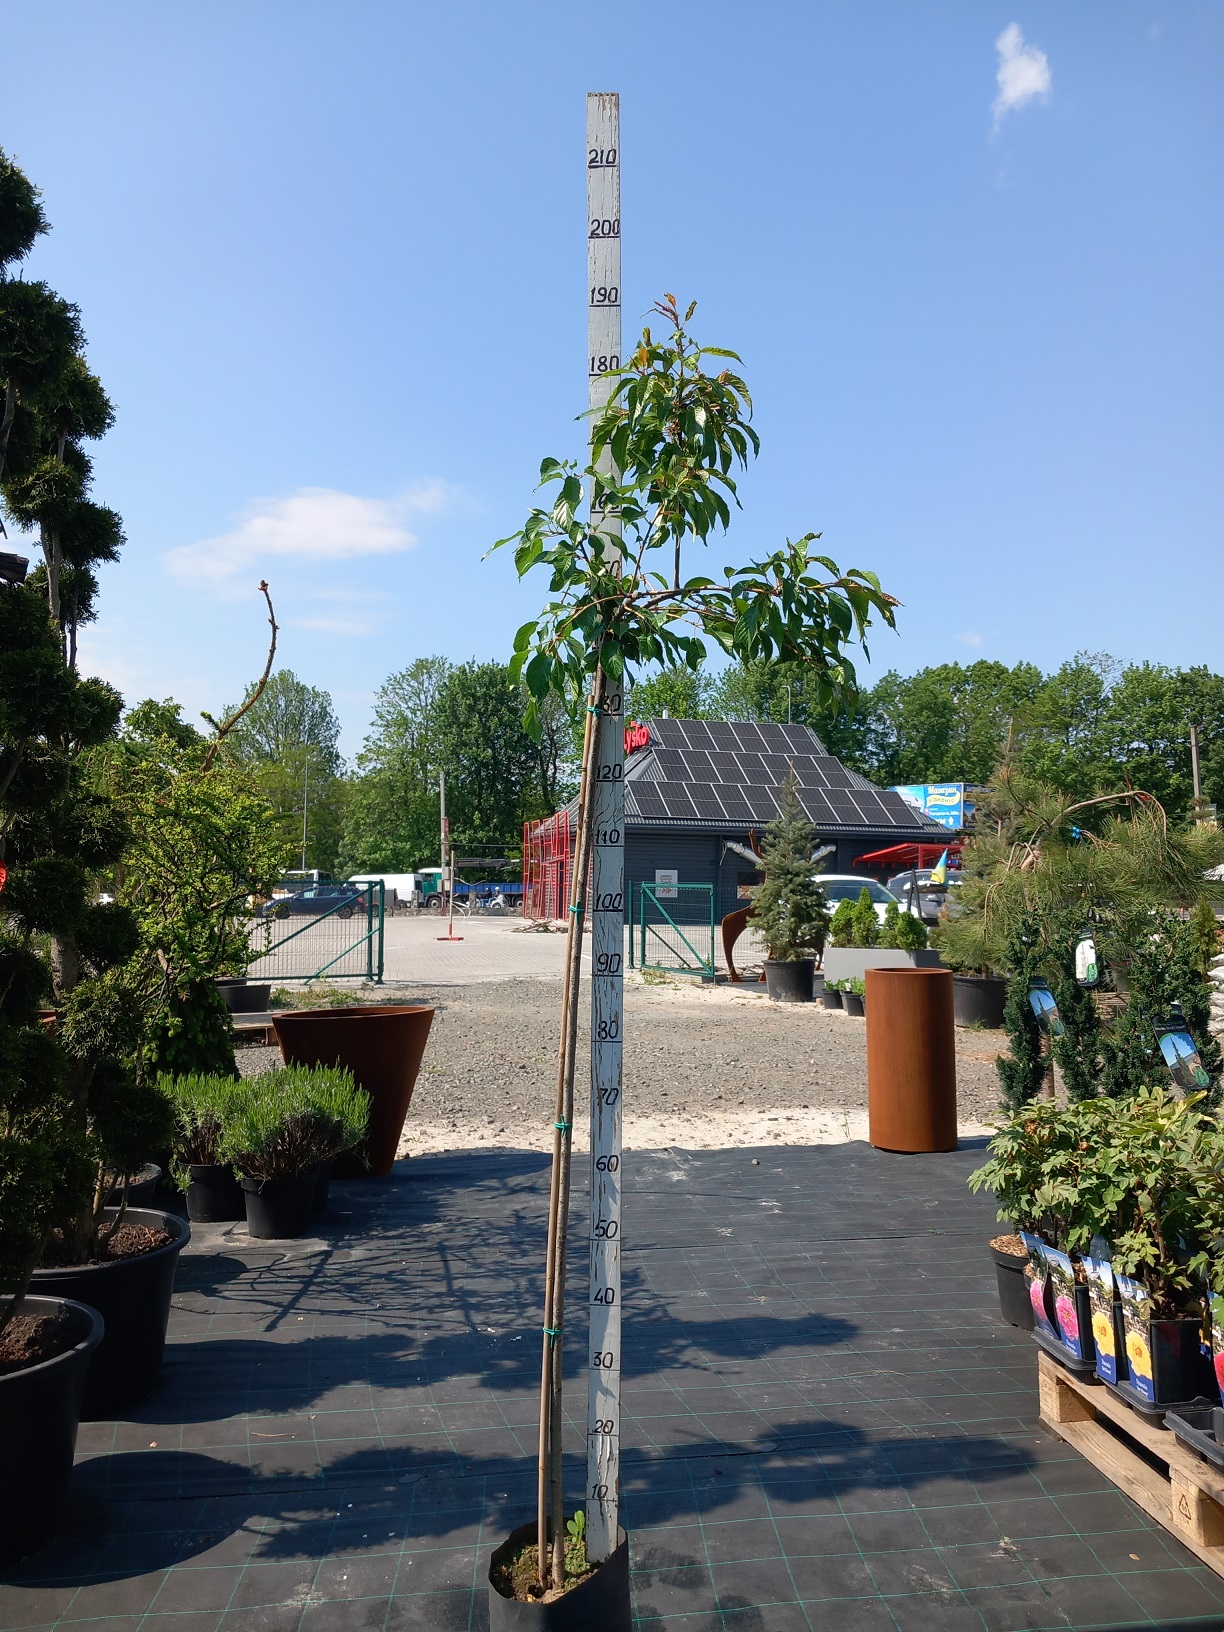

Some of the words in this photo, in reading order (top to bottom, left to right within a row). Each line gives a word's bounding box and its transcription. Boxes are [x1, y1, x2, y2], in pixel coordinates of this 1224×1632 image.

[588, 148, 617, 165] 210
[590, 219, 620, 236] 200
[590, 287, 618, 303] 190
[590, 355, 620, 372] 180
[596, 763, 623, 779] 120
[596, 893, 621, 909] 100
[597, 953, 621, 974] 90
[598, 1020, 618, 1039] 80
[597, 1088, 618, 1106] 70
[596, 1154, 619, 1172] 60
[594, 1220, 618, 1239] 50
[593, 1287, 615, 1304] 40
[593, 1351, 614, 1369] 30
[594, 1419, 614, 1434] 20
[592, 1484, 608, 1499] 10
